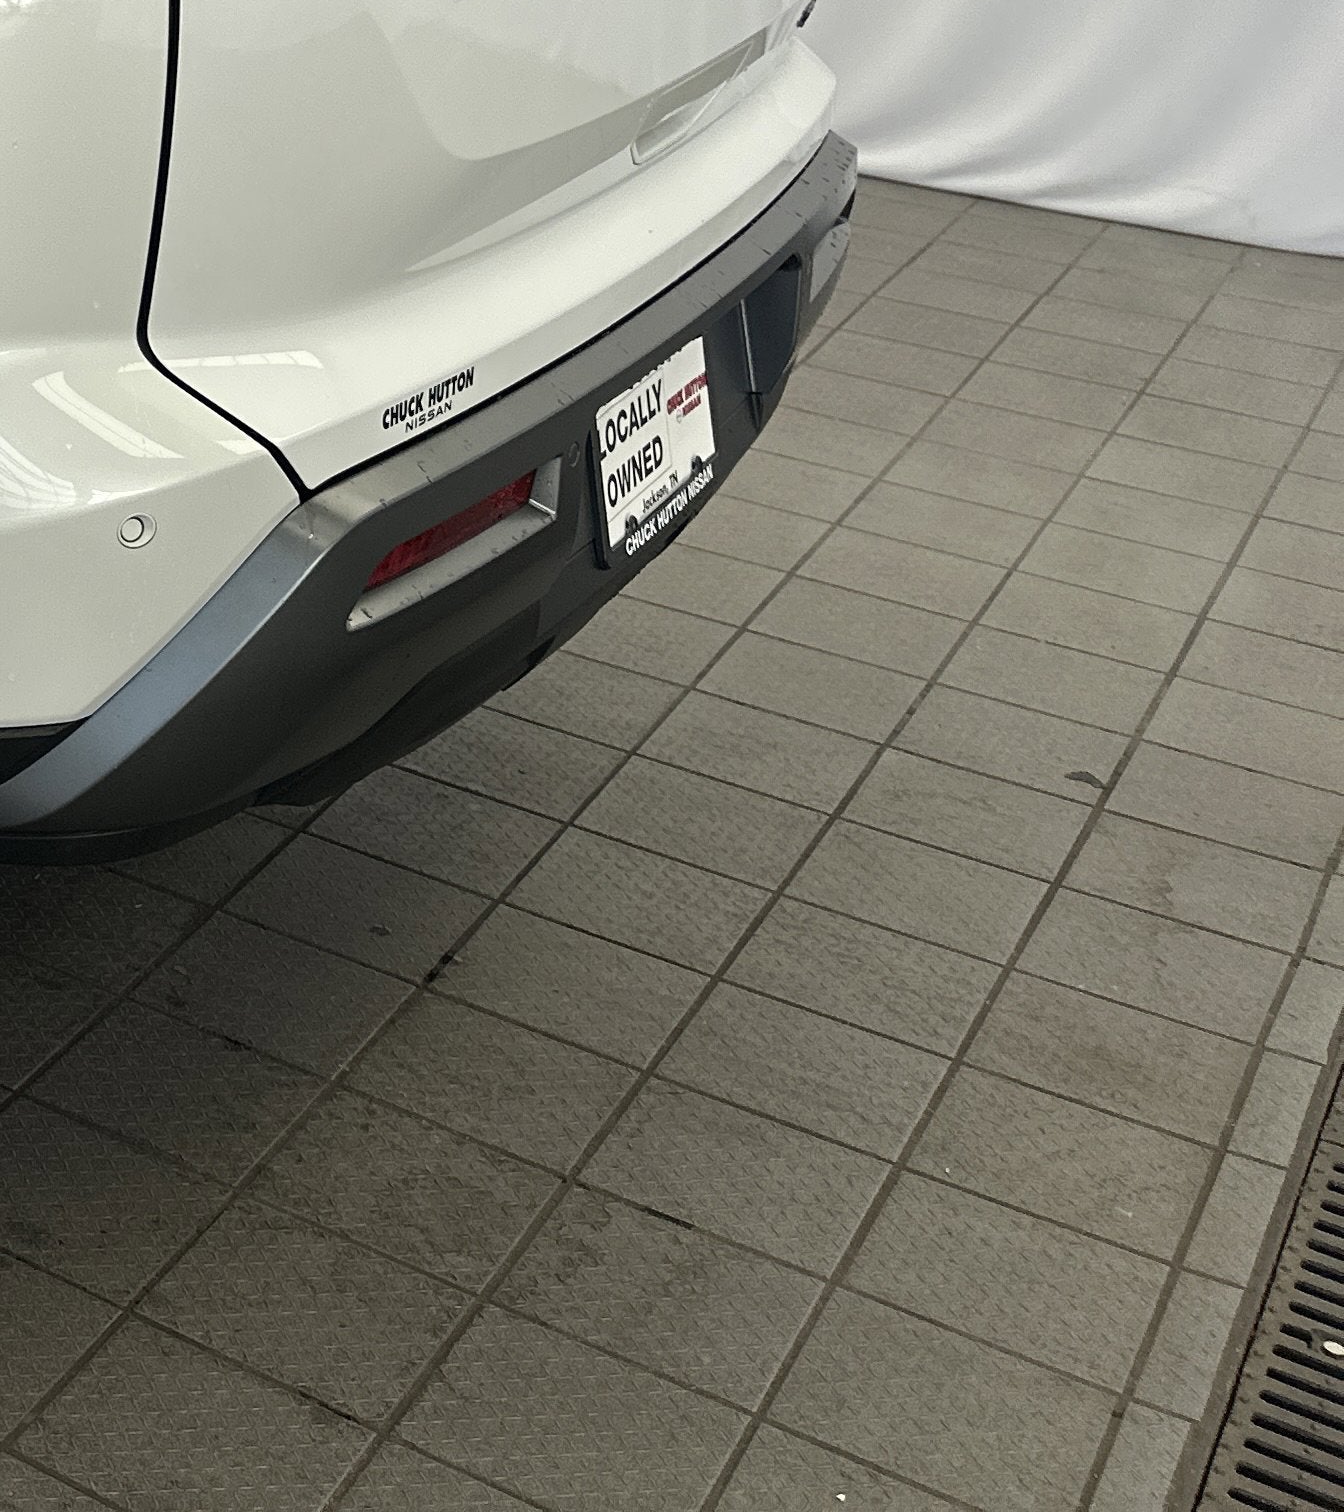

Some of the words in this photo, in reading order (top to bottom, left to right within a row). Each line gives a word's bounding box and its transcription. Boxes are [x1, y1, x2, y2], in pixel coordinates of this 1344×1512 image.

[382, 391, 424, 429] CHUCK
[428, 366, 474, 408] HUTTON
[405, 399, 453, 433] NISSAN
[607, 434, 663, 508] OWNED
[669, 469, 679, 487] TN
[626, 517, 658, 556] CHUCK
[656, 489, 688, 530] HUTTON
[687, 463, 714, 501] NISSAN
